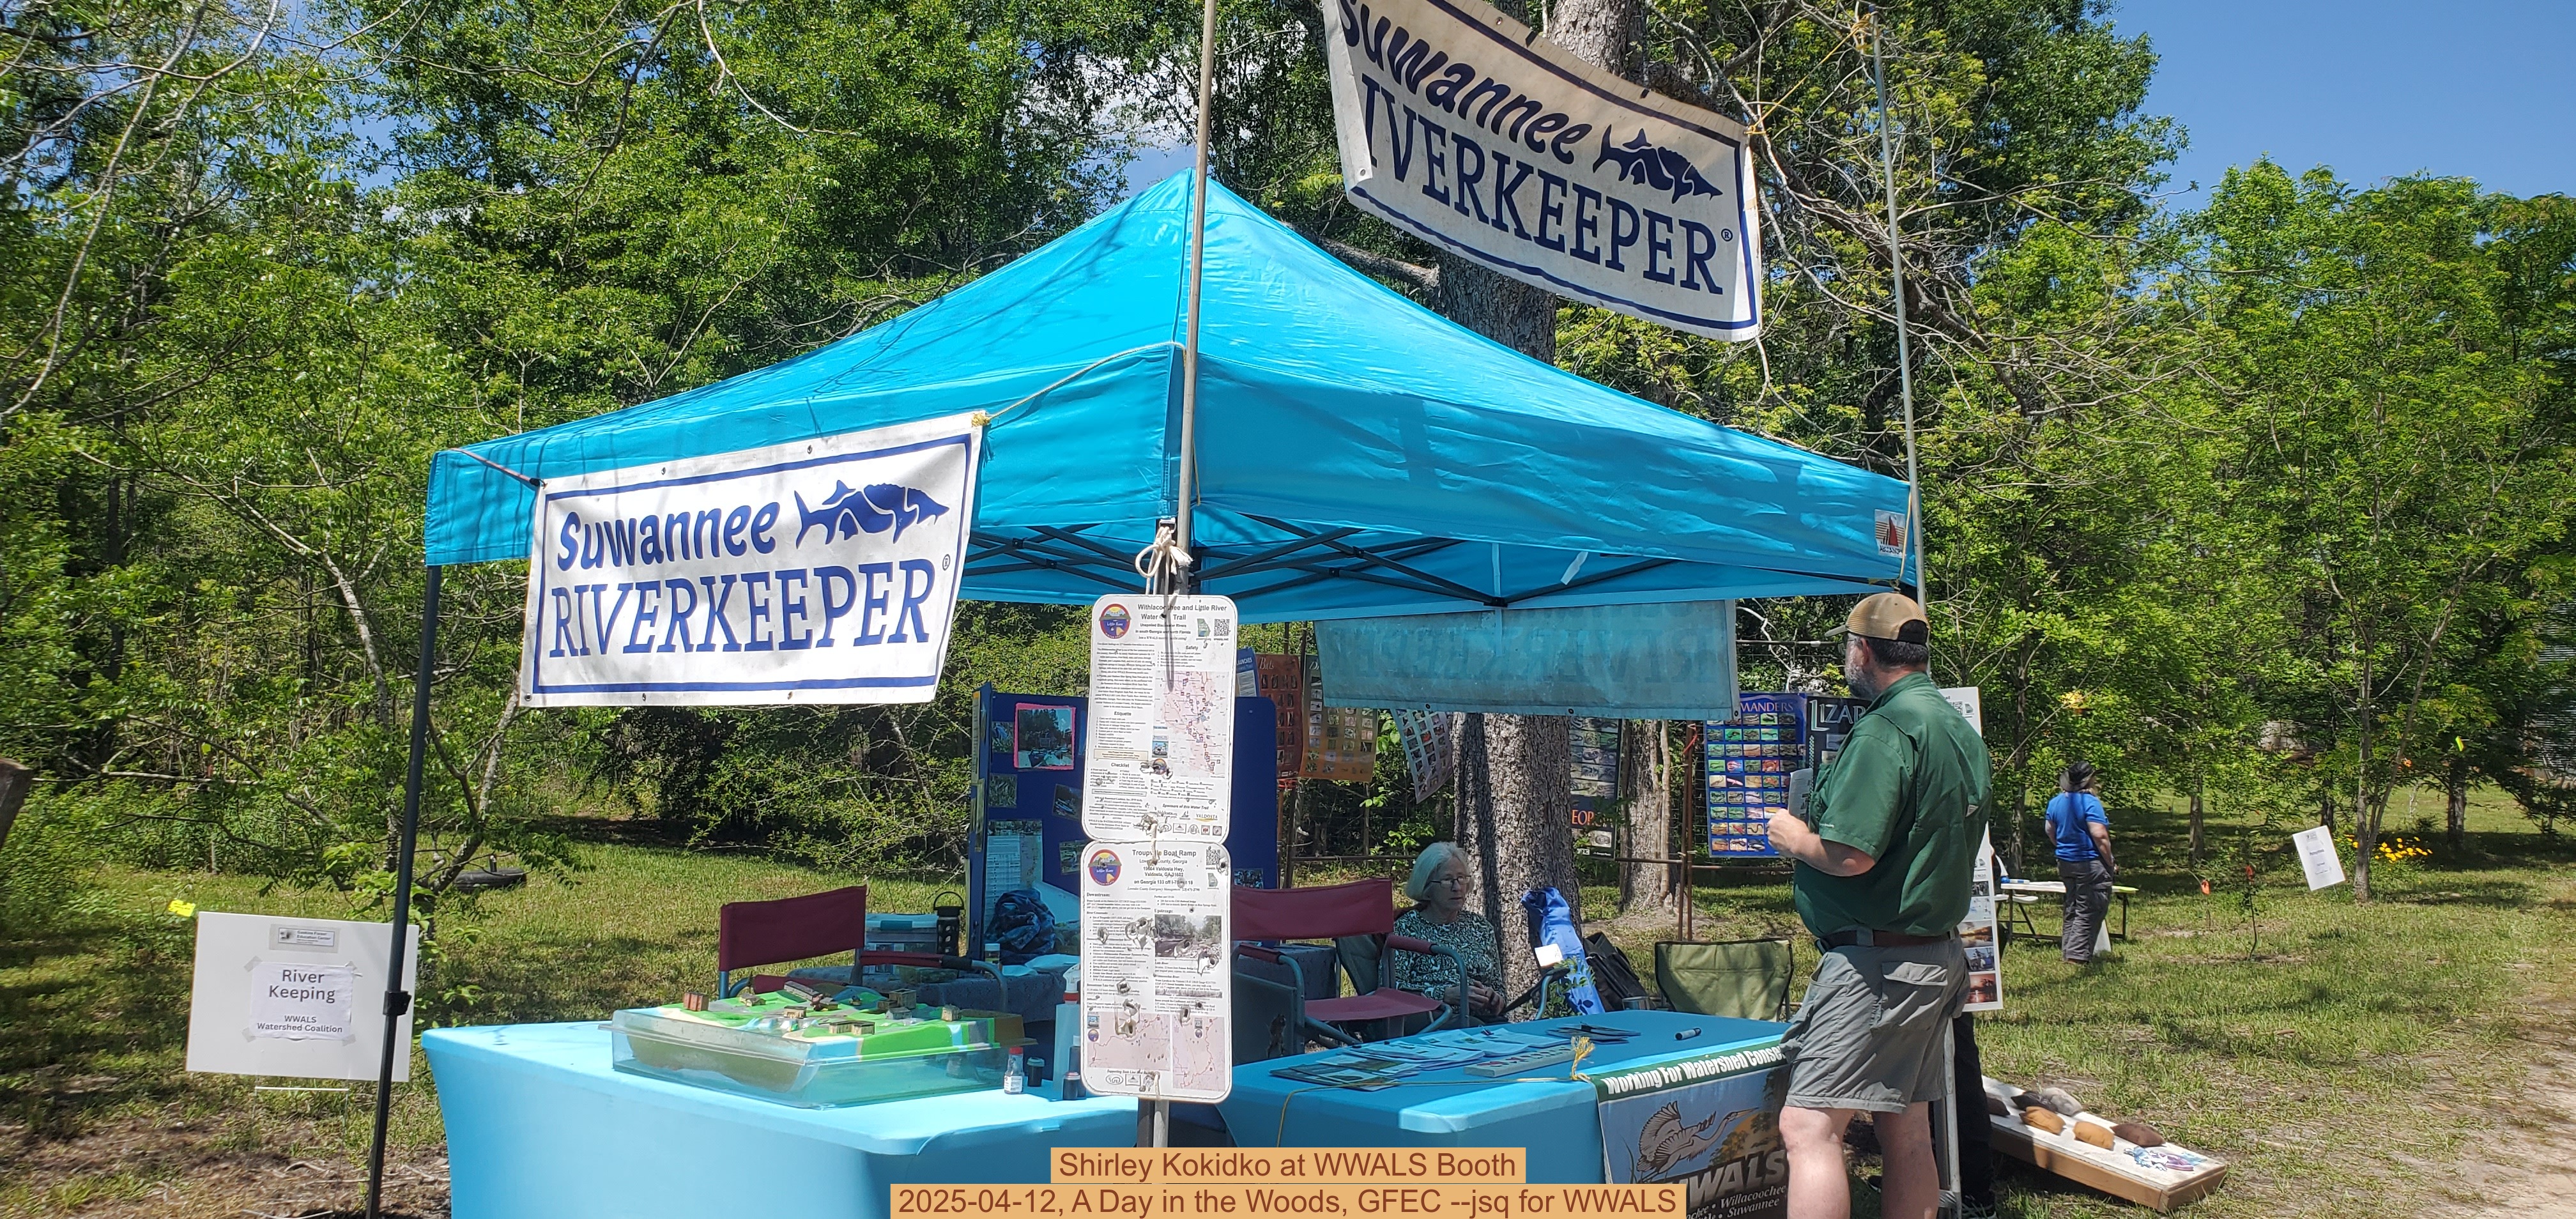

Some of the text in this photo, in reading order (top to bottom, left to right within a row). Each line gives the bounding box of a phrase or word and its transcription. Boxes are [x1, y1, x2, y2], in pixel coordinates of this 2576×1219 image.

[1340, 0, 1592, 164] Suwannee
[557, 502, 780, 571] Suwannee
[1809, 700, 1870, 731] LIZAR
[282, 969, 325, 984] River
[269, 985, 335, 1004] Keeping
[257, 1022, 342, 1033] Watershed Coalition
[1600, 1070, 1662, 1094] Working
[1657, 1066, 1682, 1084] For
[1678, 1052, 1749, 1080] Watershed
[1664, 1149, 1786, 1209] WALS
[1721, 1185, 1786, 1209] Willacoochee
[1727, 1197, 1780, 1218] Suwannee
